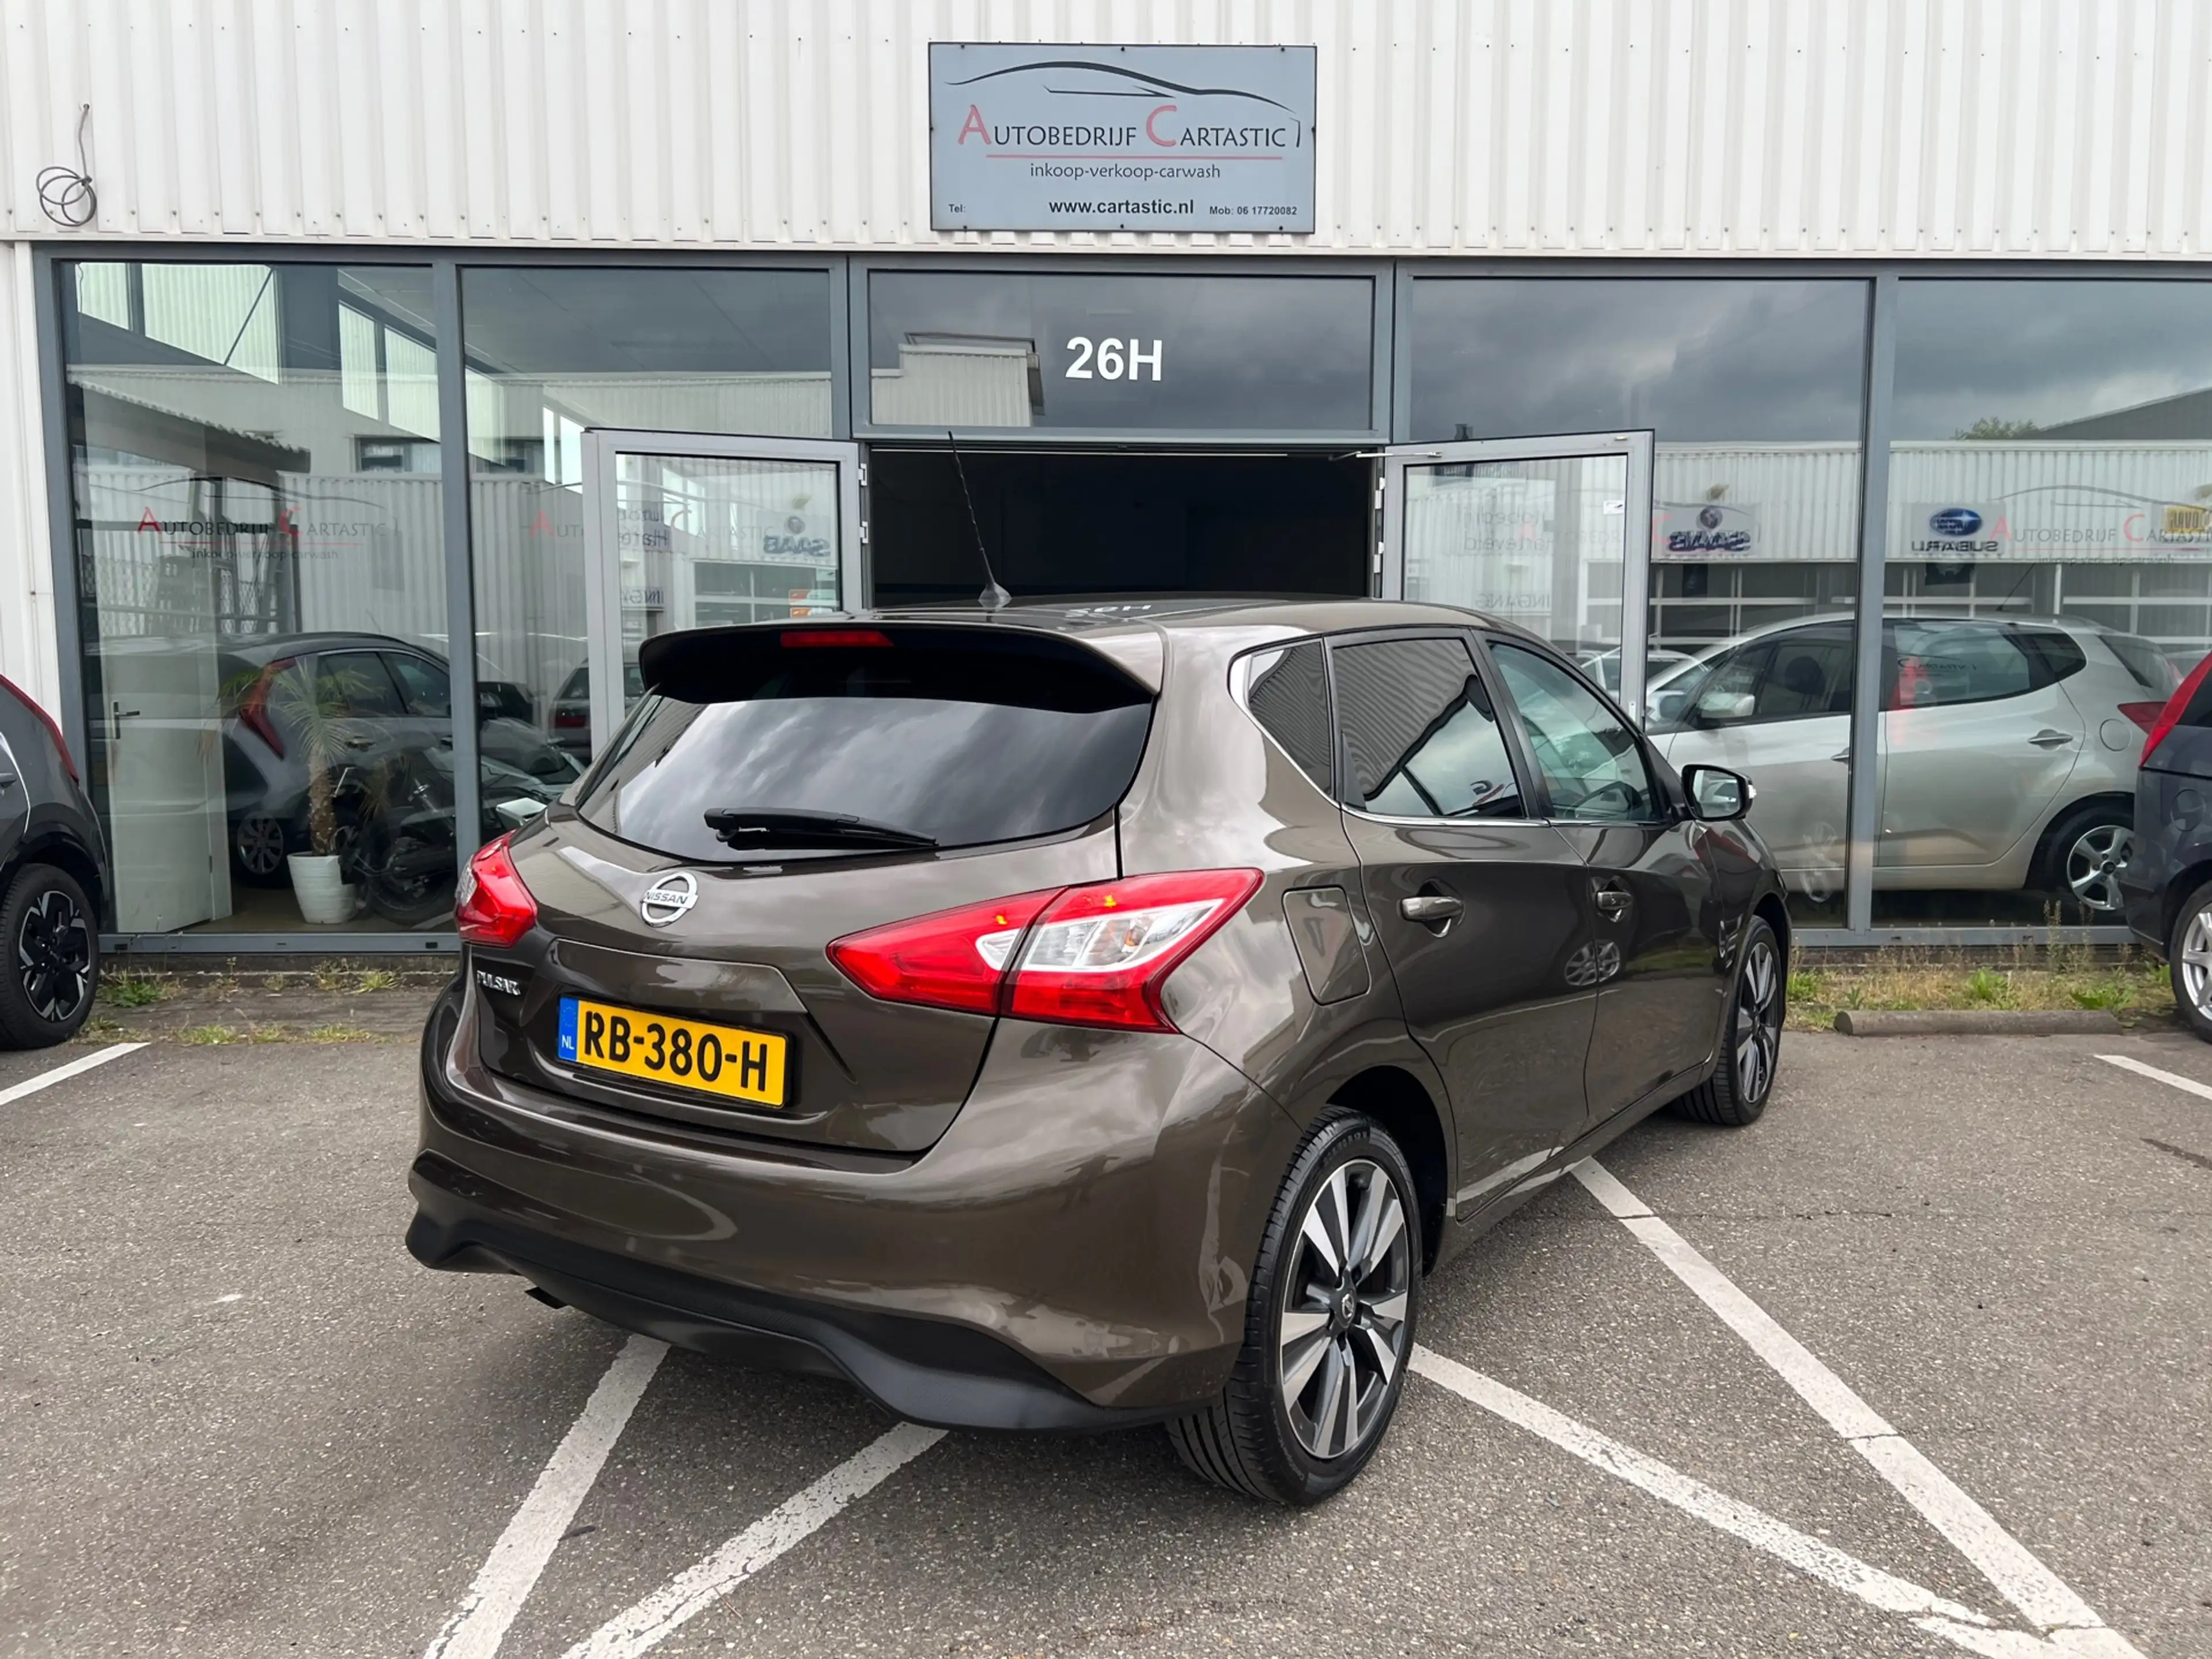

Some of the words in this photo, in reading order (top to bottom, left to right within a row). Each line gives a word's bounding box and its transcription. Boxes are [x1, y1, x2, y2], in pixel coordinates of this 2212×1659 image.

[957, 104, 1137, 146] AUTOBEDRIJF
[1146, 105, 1286, 147] CARTASTIC
[1030, 162, 1221, 181] inkoop-verkoop-carwash
[949, 204, 966, 213] Tel:
[1049, 199, 1194, 215] www.cartastic.nl
[1209, 206, 1234, 215] Mob:
[1237, 206, 1249, 215] 06
[1252, 206, 1298, 215] 17720082
[1066, 336, 1162, 381] 26H
[1989, 515, 2116, 543] AUTOBEDRIJF
[2123, 513, 2212, 543] CARTASTI
[645, 891, 688, 904] NISSAN
[562, 1034, 575, 1051] NL
[584, 1010, 768, 1092] RB-380-H
